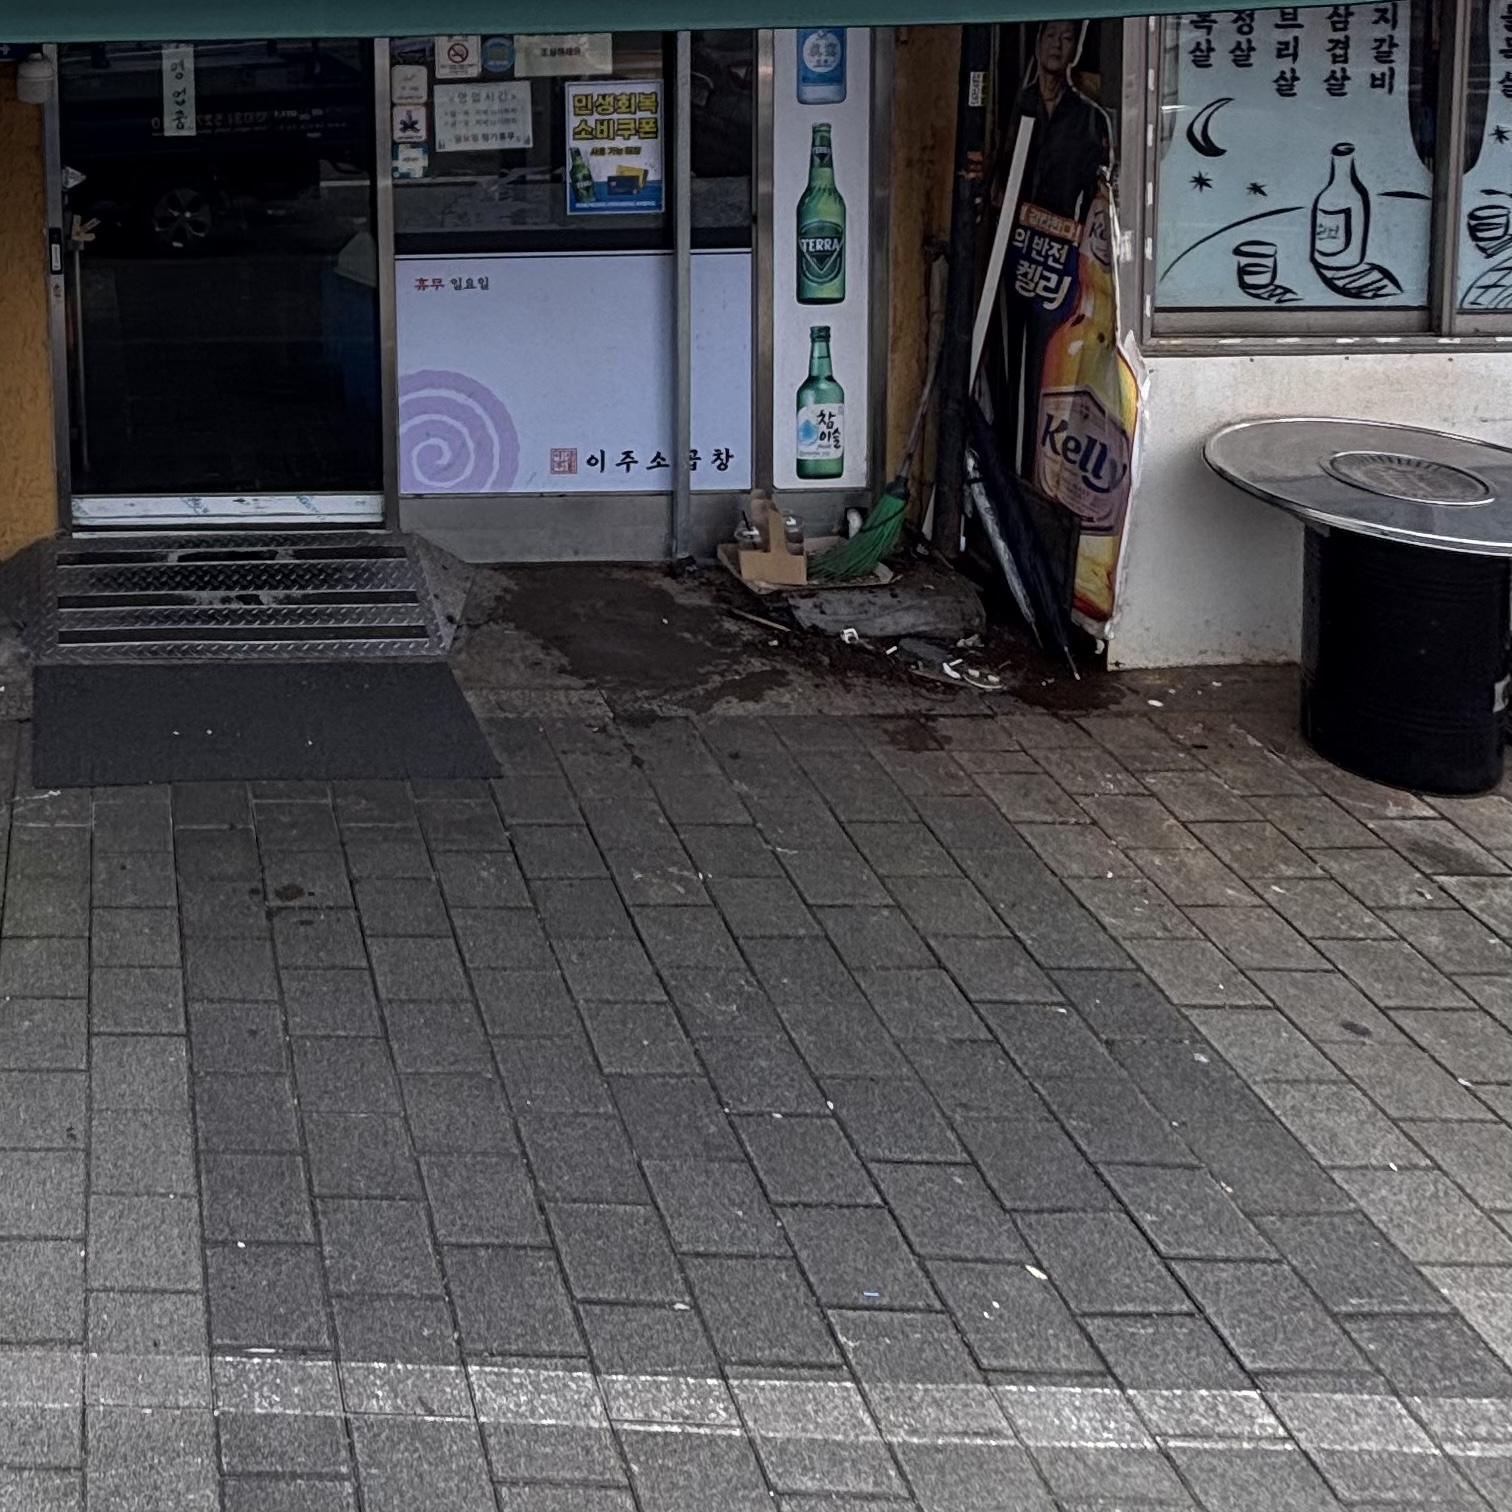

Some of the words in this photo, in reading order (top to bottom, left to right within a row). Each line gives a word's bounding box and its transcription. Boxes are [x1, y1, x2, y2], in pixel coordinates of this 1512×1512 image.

[573, 92, 658, 116] 민생회복
[572, 117, 658, 141] 소비쿠폰
[801, 238, 840, 252] TERRA
[1031, 234, 1070, 270] 반전
[414, 277, 445, 291] 휴무
[450, 276, 490, 291] 일요일
[1015, 259, 1073, 311] 켈리
[817, 409, 836, 429] 참
[819, 427, 841, 449] 이슬
[1042, 413, 1129, 494] Kelly
